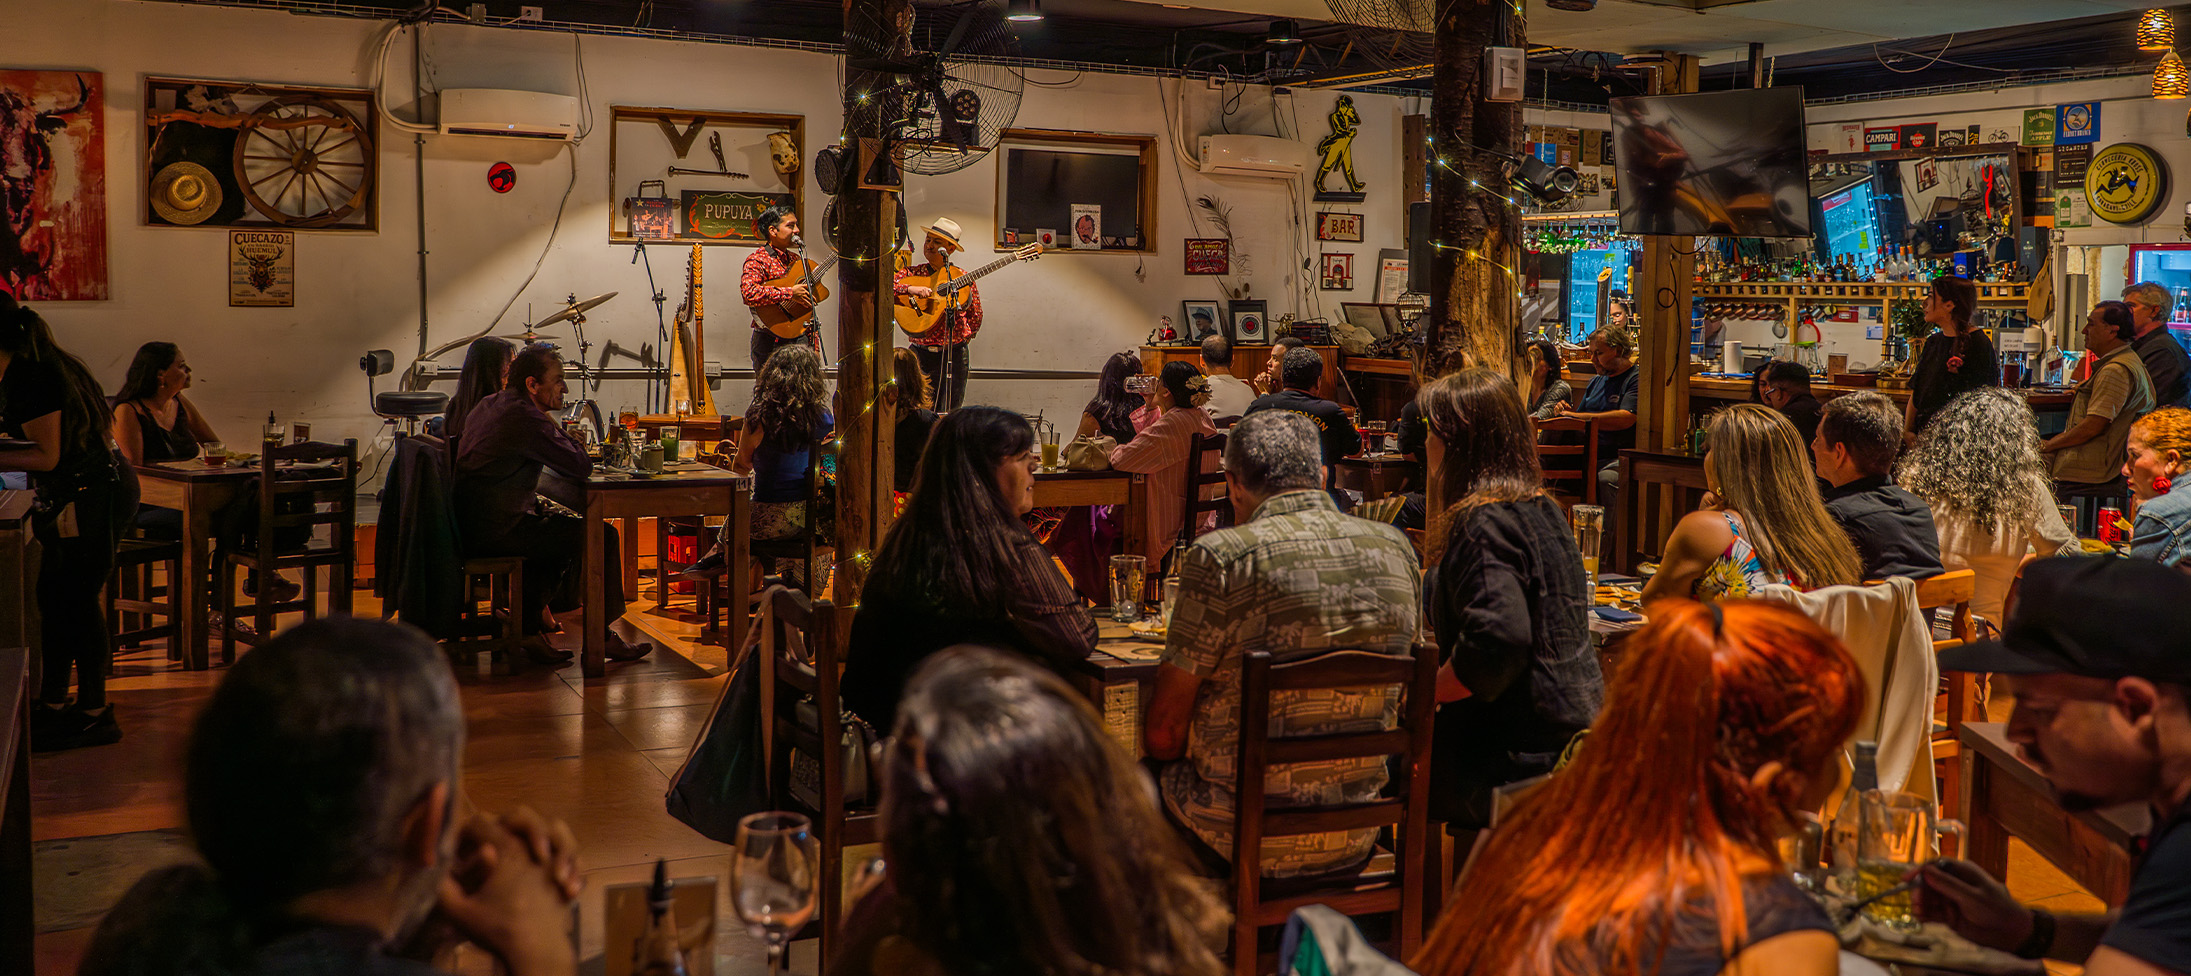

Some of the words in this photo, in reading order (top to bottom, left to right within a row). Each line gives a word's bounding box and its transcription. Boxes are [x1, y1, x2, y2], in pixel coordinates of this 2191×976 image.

[1866, 133, 1897, 143] CAMPARI
[704, 203, 753, 220] PUPUYA
[1331, 218, 1357, 236] BAR
[234, 233, 284, 245] CUECAZO
